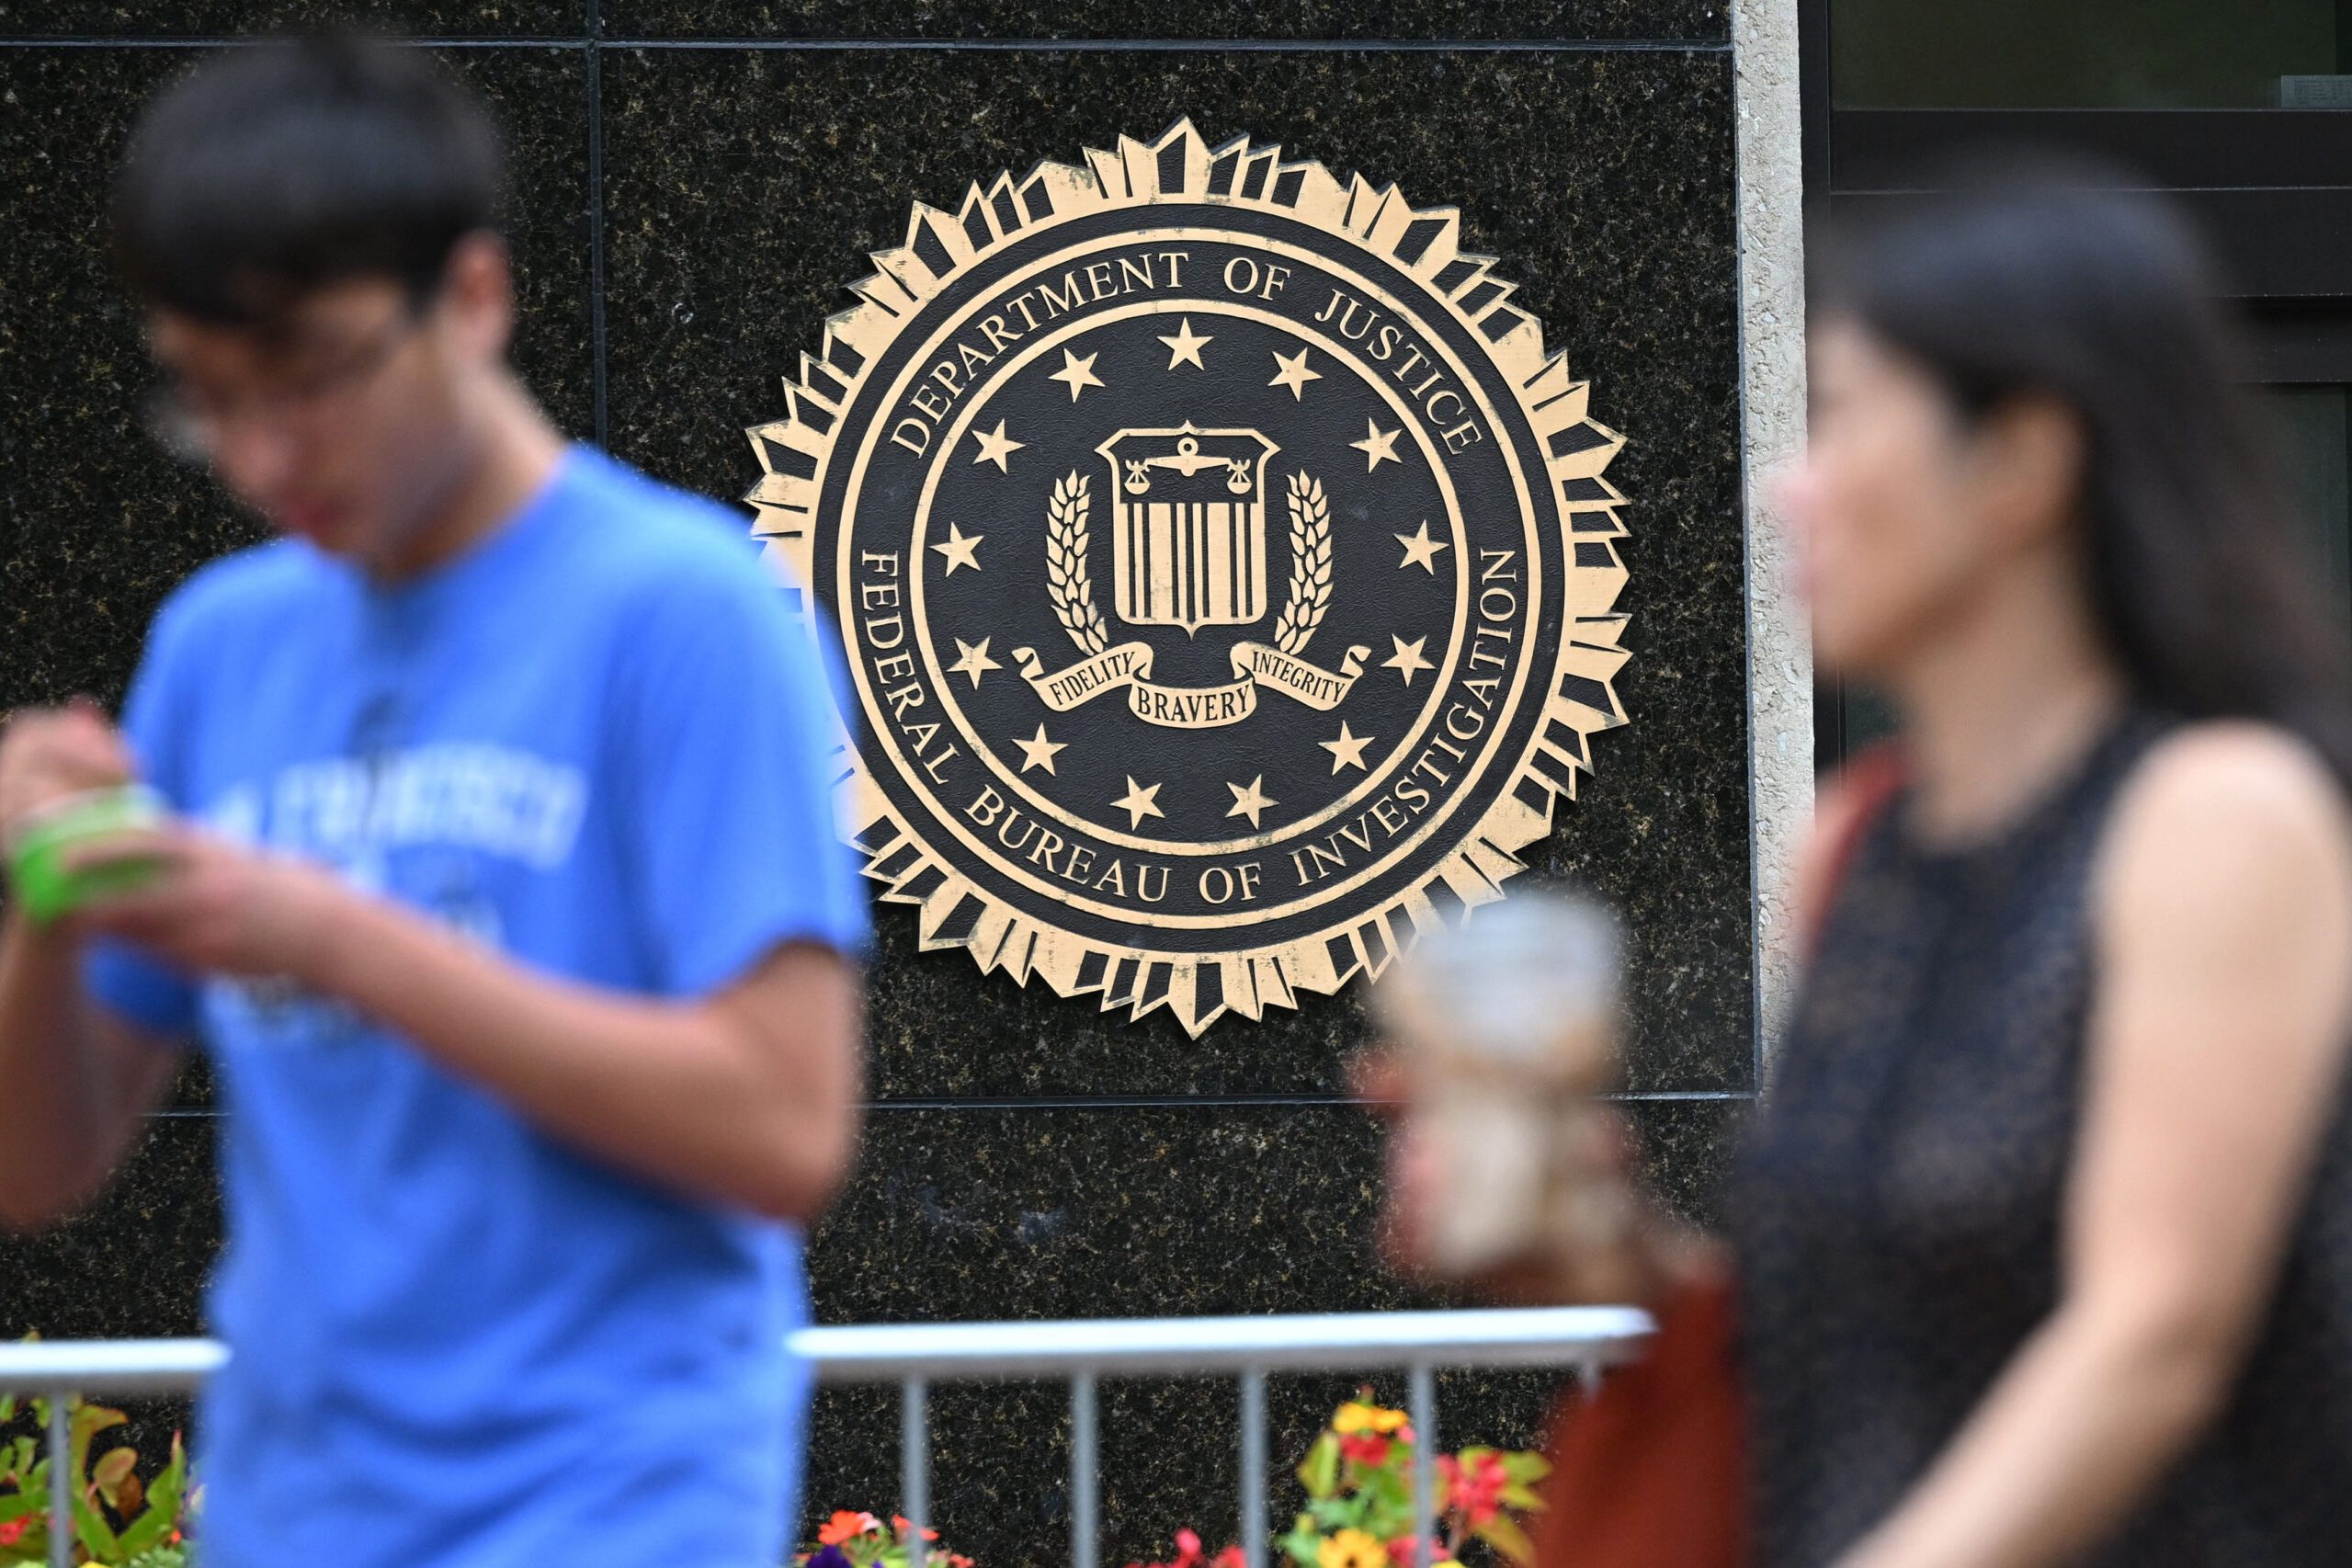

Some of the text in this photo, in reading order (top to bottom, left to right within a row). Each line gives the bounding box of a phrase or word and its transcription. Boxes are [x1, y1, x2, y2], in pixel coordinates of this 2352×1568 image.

[889, 252, 1483, 459] DEPARTMENT OF JUSTICE
[1048, 651, 1136, 706] FIDELITY
[1137, 685, 1250, 722] BRAVERY
[1252, 651, 1346, 703] INTEGRITY
[861, 547, 1518, 904] FEDERAL BUREAU OF INVESTIGATION
